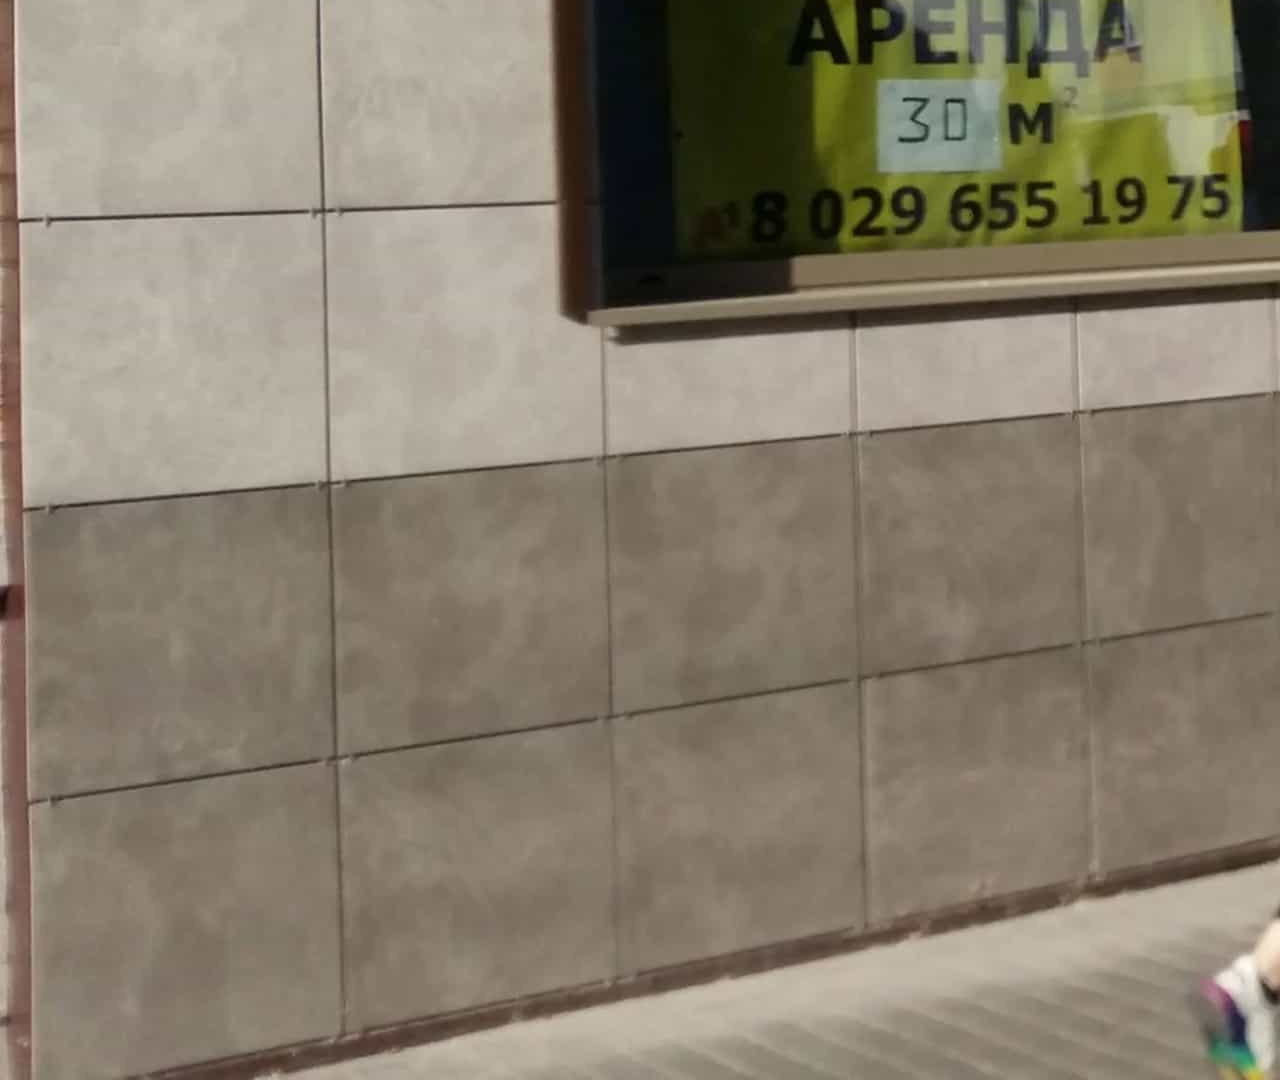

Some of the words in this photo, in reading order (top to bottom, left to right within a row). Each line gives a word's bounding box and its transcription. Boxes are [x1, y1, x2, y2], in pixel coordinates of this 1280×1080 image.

[897, 96, 968, 143] 30
[753, 191, 788, 243] 8
[809, 185, 926, 238] 029
[949, 181, 1058, 233] 655
[1082, 176, 1147, 225] 19
[1166, 173, 1230, 220] 75
